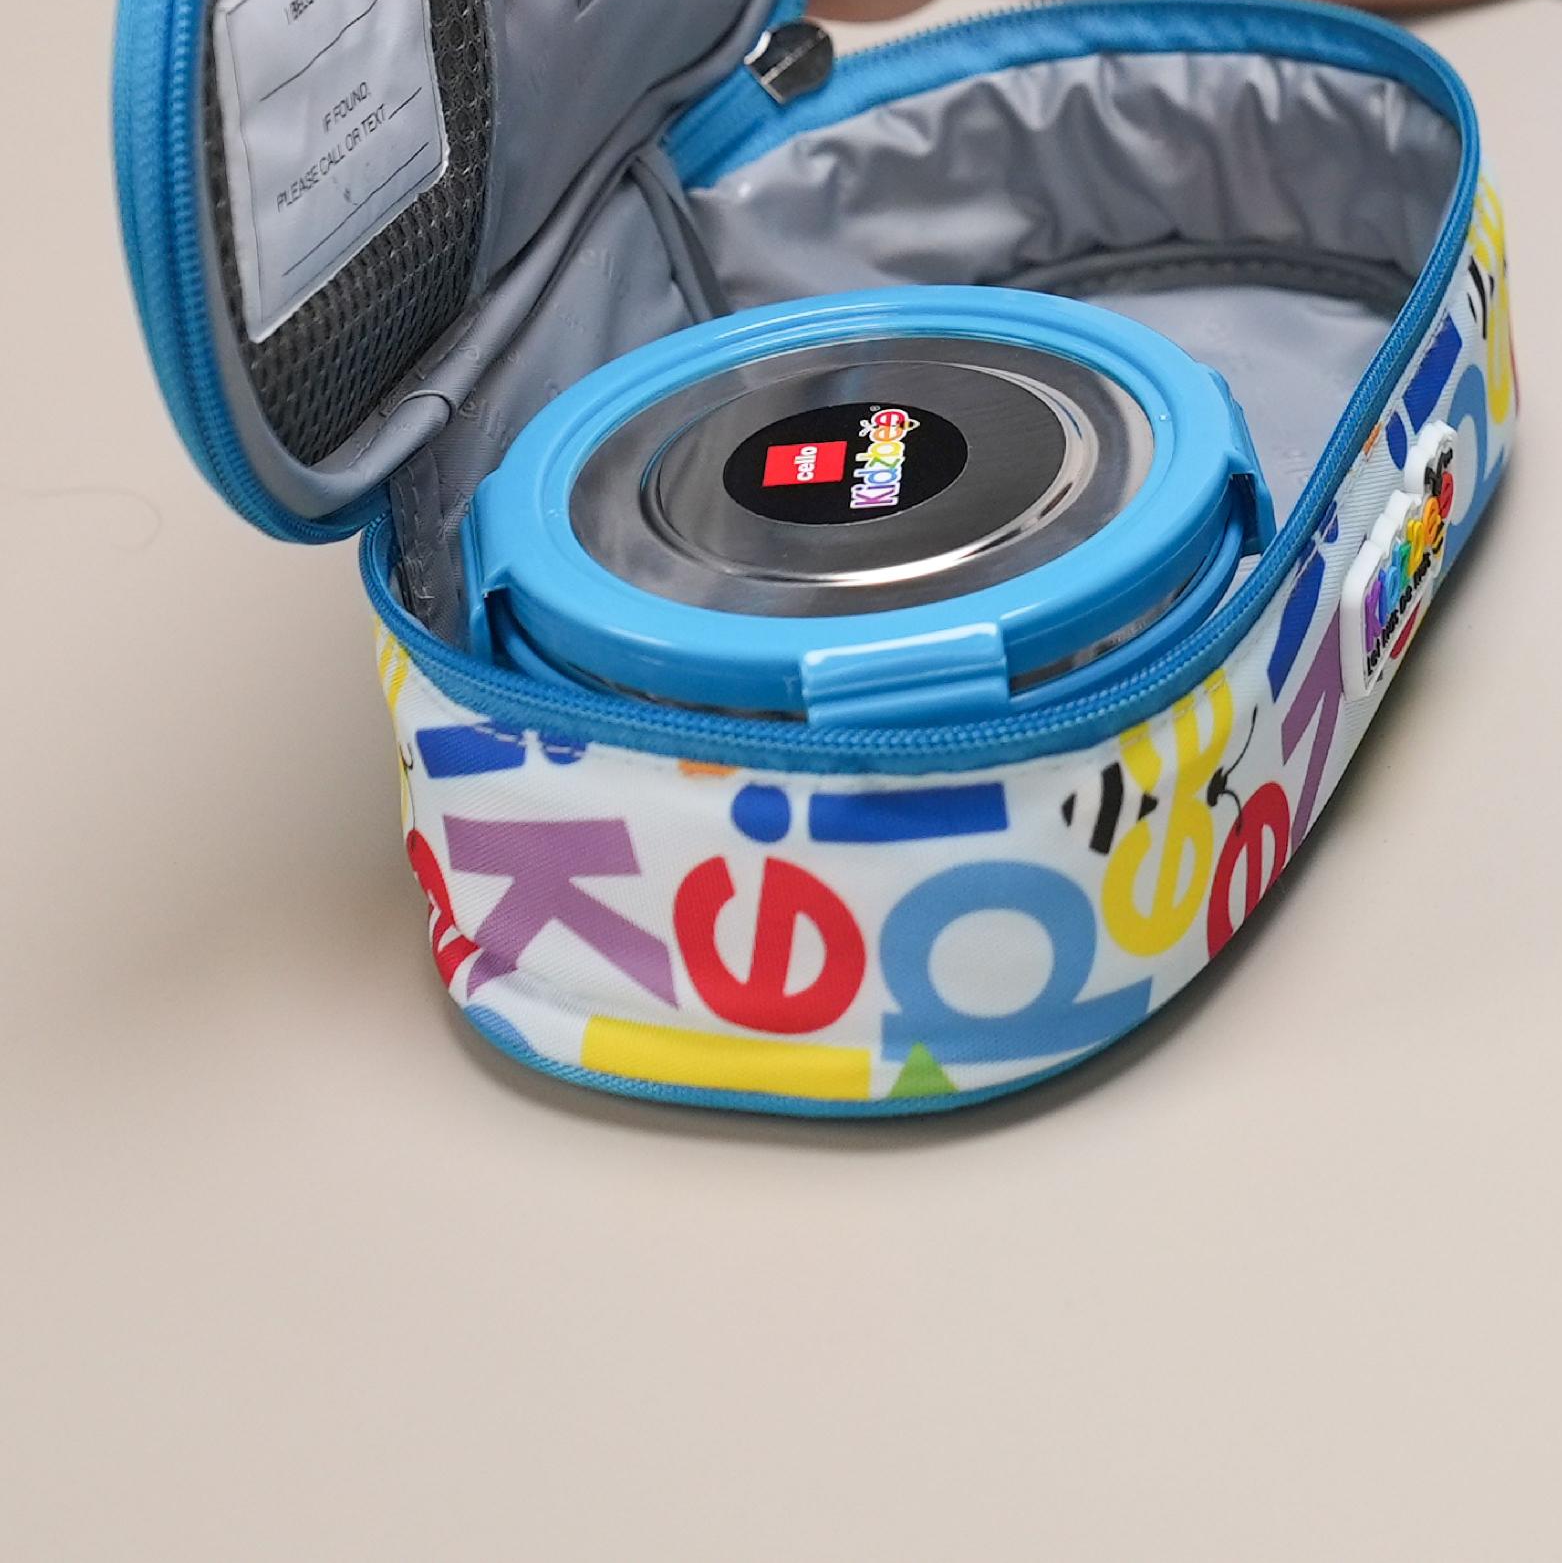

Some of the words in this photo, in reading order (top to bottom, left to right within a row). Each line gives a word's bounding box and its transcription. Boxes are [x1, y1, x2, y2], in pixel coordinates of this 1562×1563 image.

[275, 164, 320, 213] PLEASE
[319, 144, 346, 176] CALL
[345, 127, 362, 153] OR
[360, 102, 386, 136] TEXT
[794, 445, 818, 482] cello
